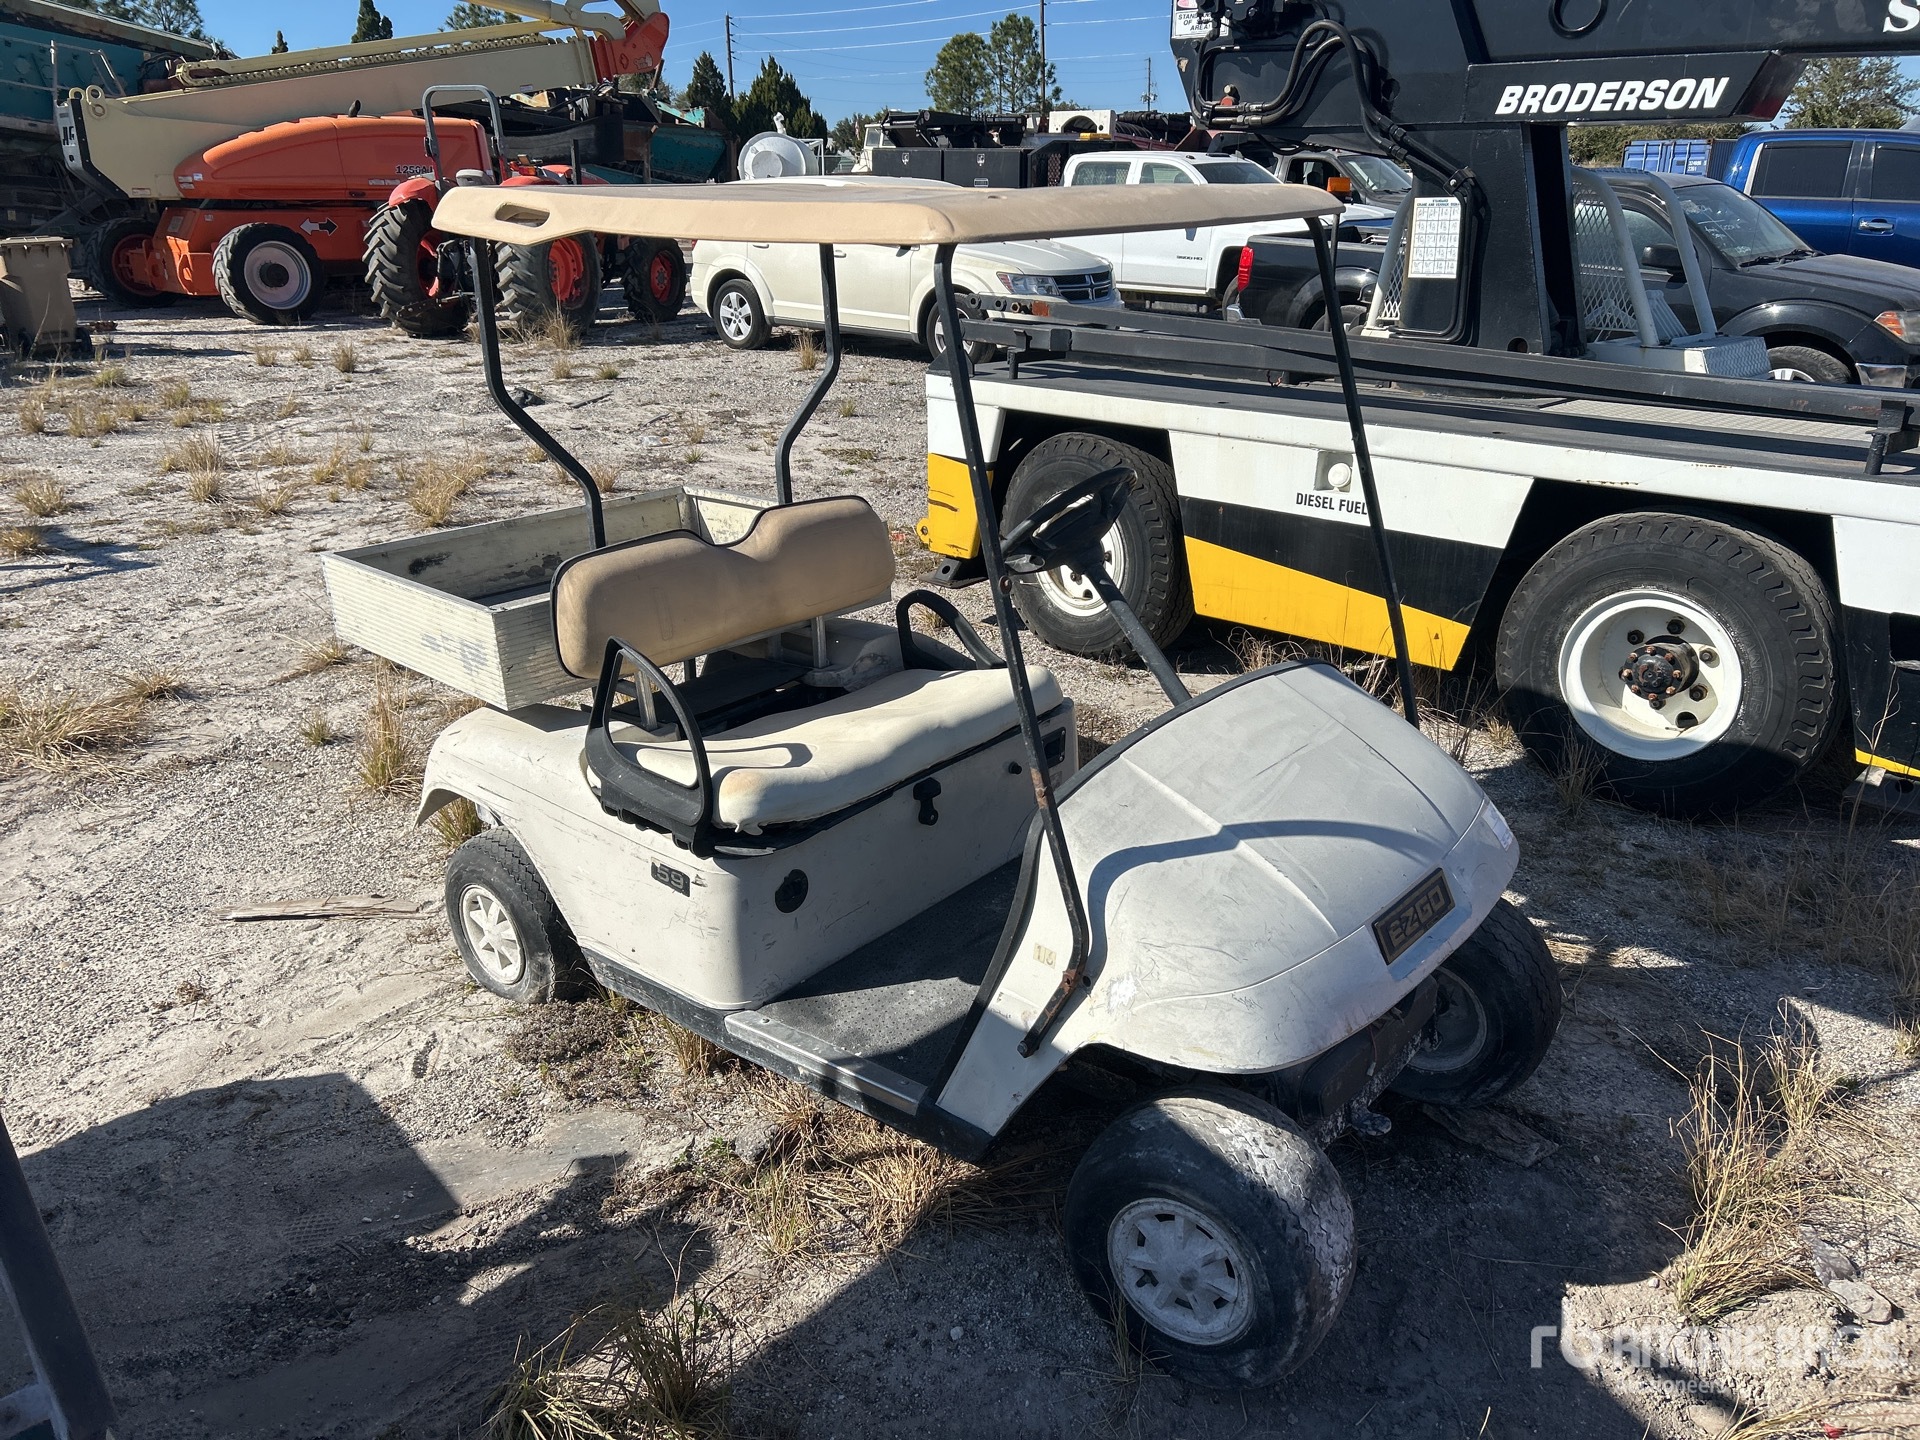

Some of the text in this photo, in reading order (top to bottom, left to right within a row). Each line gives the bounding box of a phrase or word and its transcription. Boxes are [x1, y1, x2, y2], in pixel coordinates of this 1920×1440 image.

[1495, 77, 1729, 114] BRODERSON
[1296, 492, 1368, 516] DIESEL FUEL
[656, 864, 684, 890] 59
